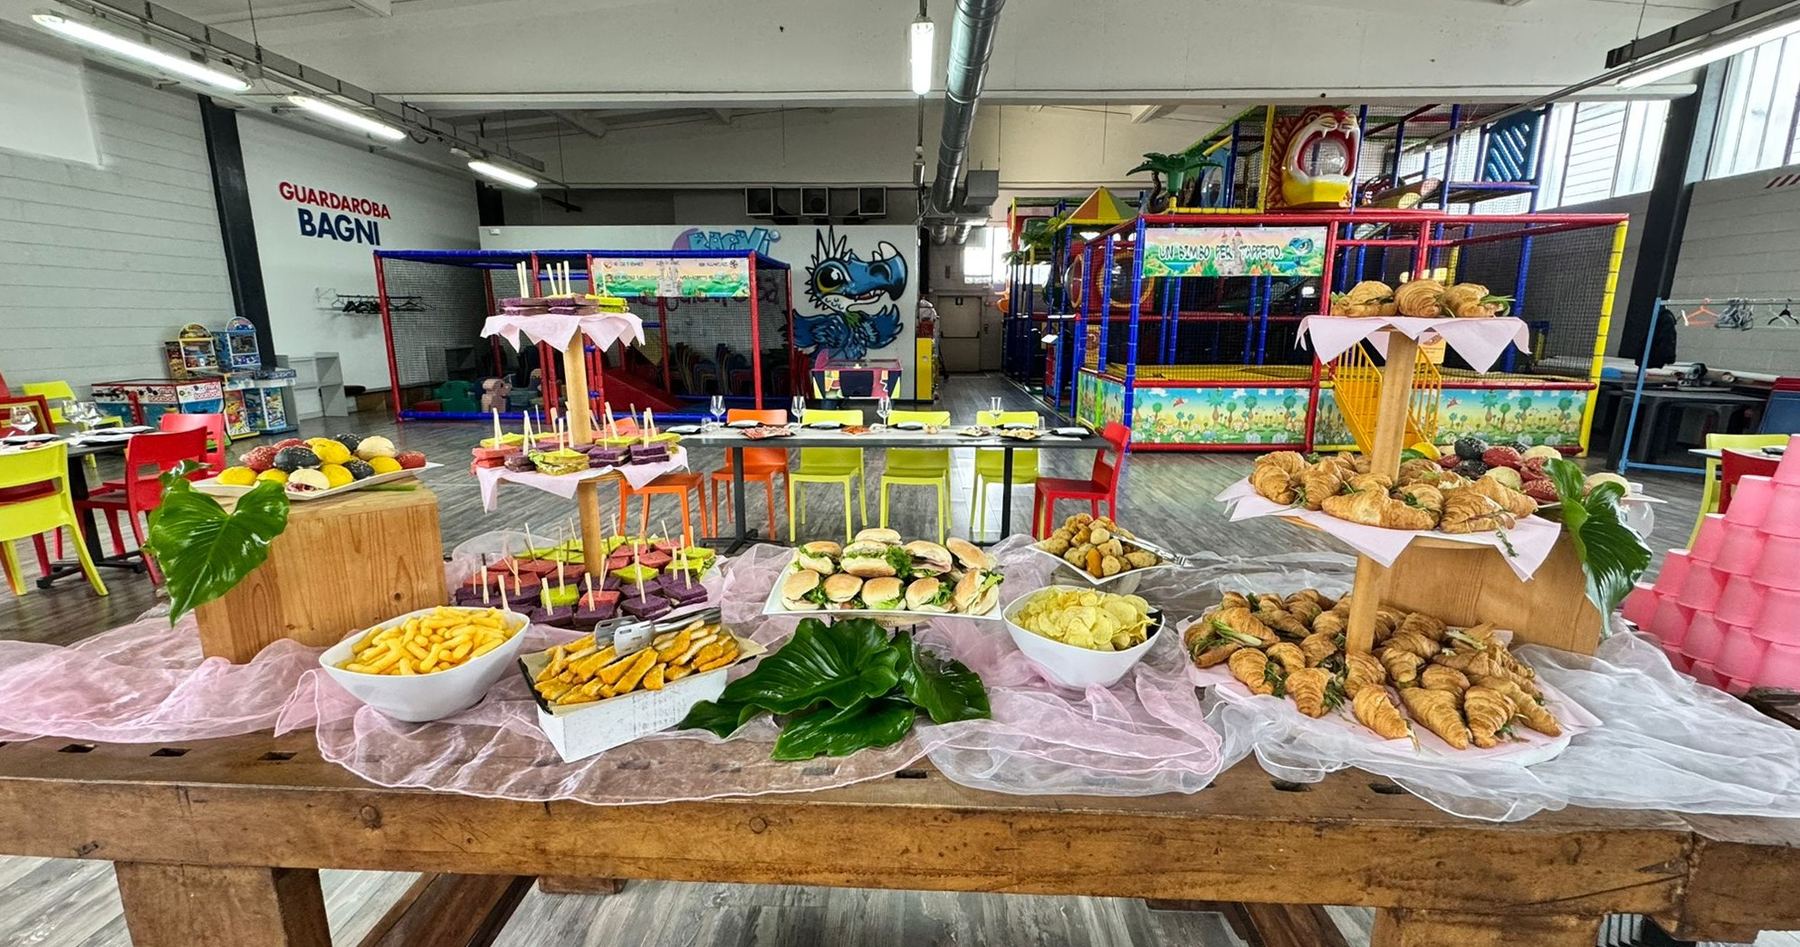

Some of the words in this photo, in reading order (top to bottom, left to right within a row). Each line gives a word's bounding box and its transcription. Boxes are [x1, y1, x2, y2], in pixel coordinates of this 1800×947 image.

[279, 181, 391, 219] GUARDAROBA
[297, 208, 381, 246] BAGNI
[1159, 244, 1174, 259] UN
[1178, 244, 1211, 259] BIMBO
[1215, 244, 1233, 259] PER
